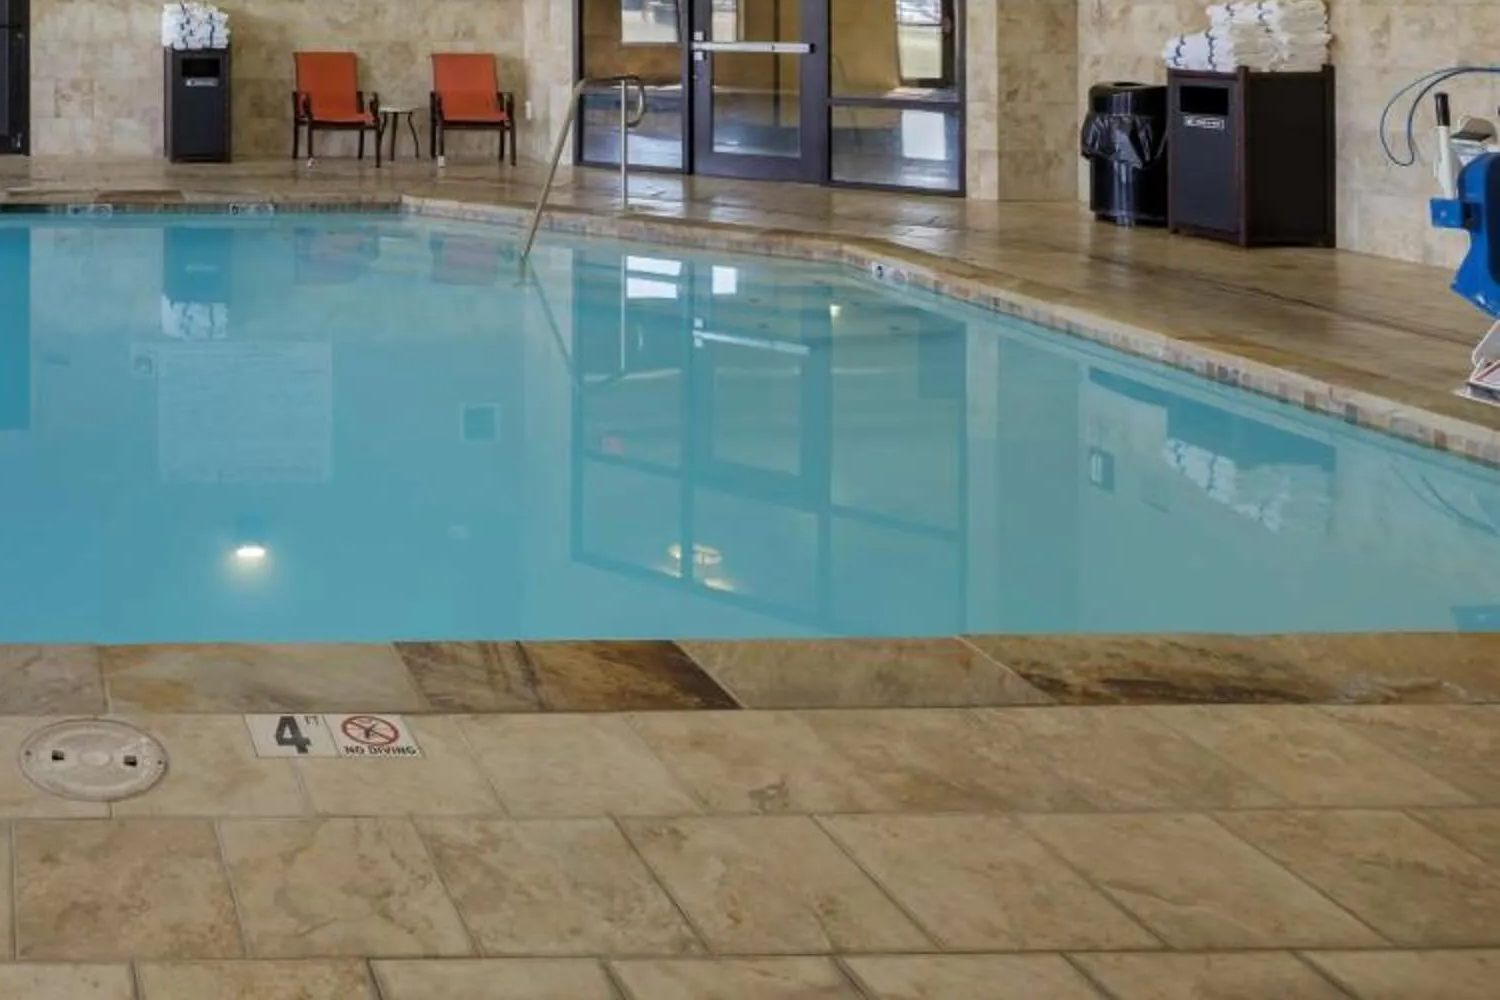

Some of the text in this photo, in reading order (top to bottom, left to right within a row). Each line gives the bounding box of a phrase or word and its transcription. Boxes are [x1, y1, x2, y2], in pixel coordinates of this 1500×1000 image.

[275, 715, 312, 754] 4
[343, 743, 417, 756] NO DIVING
